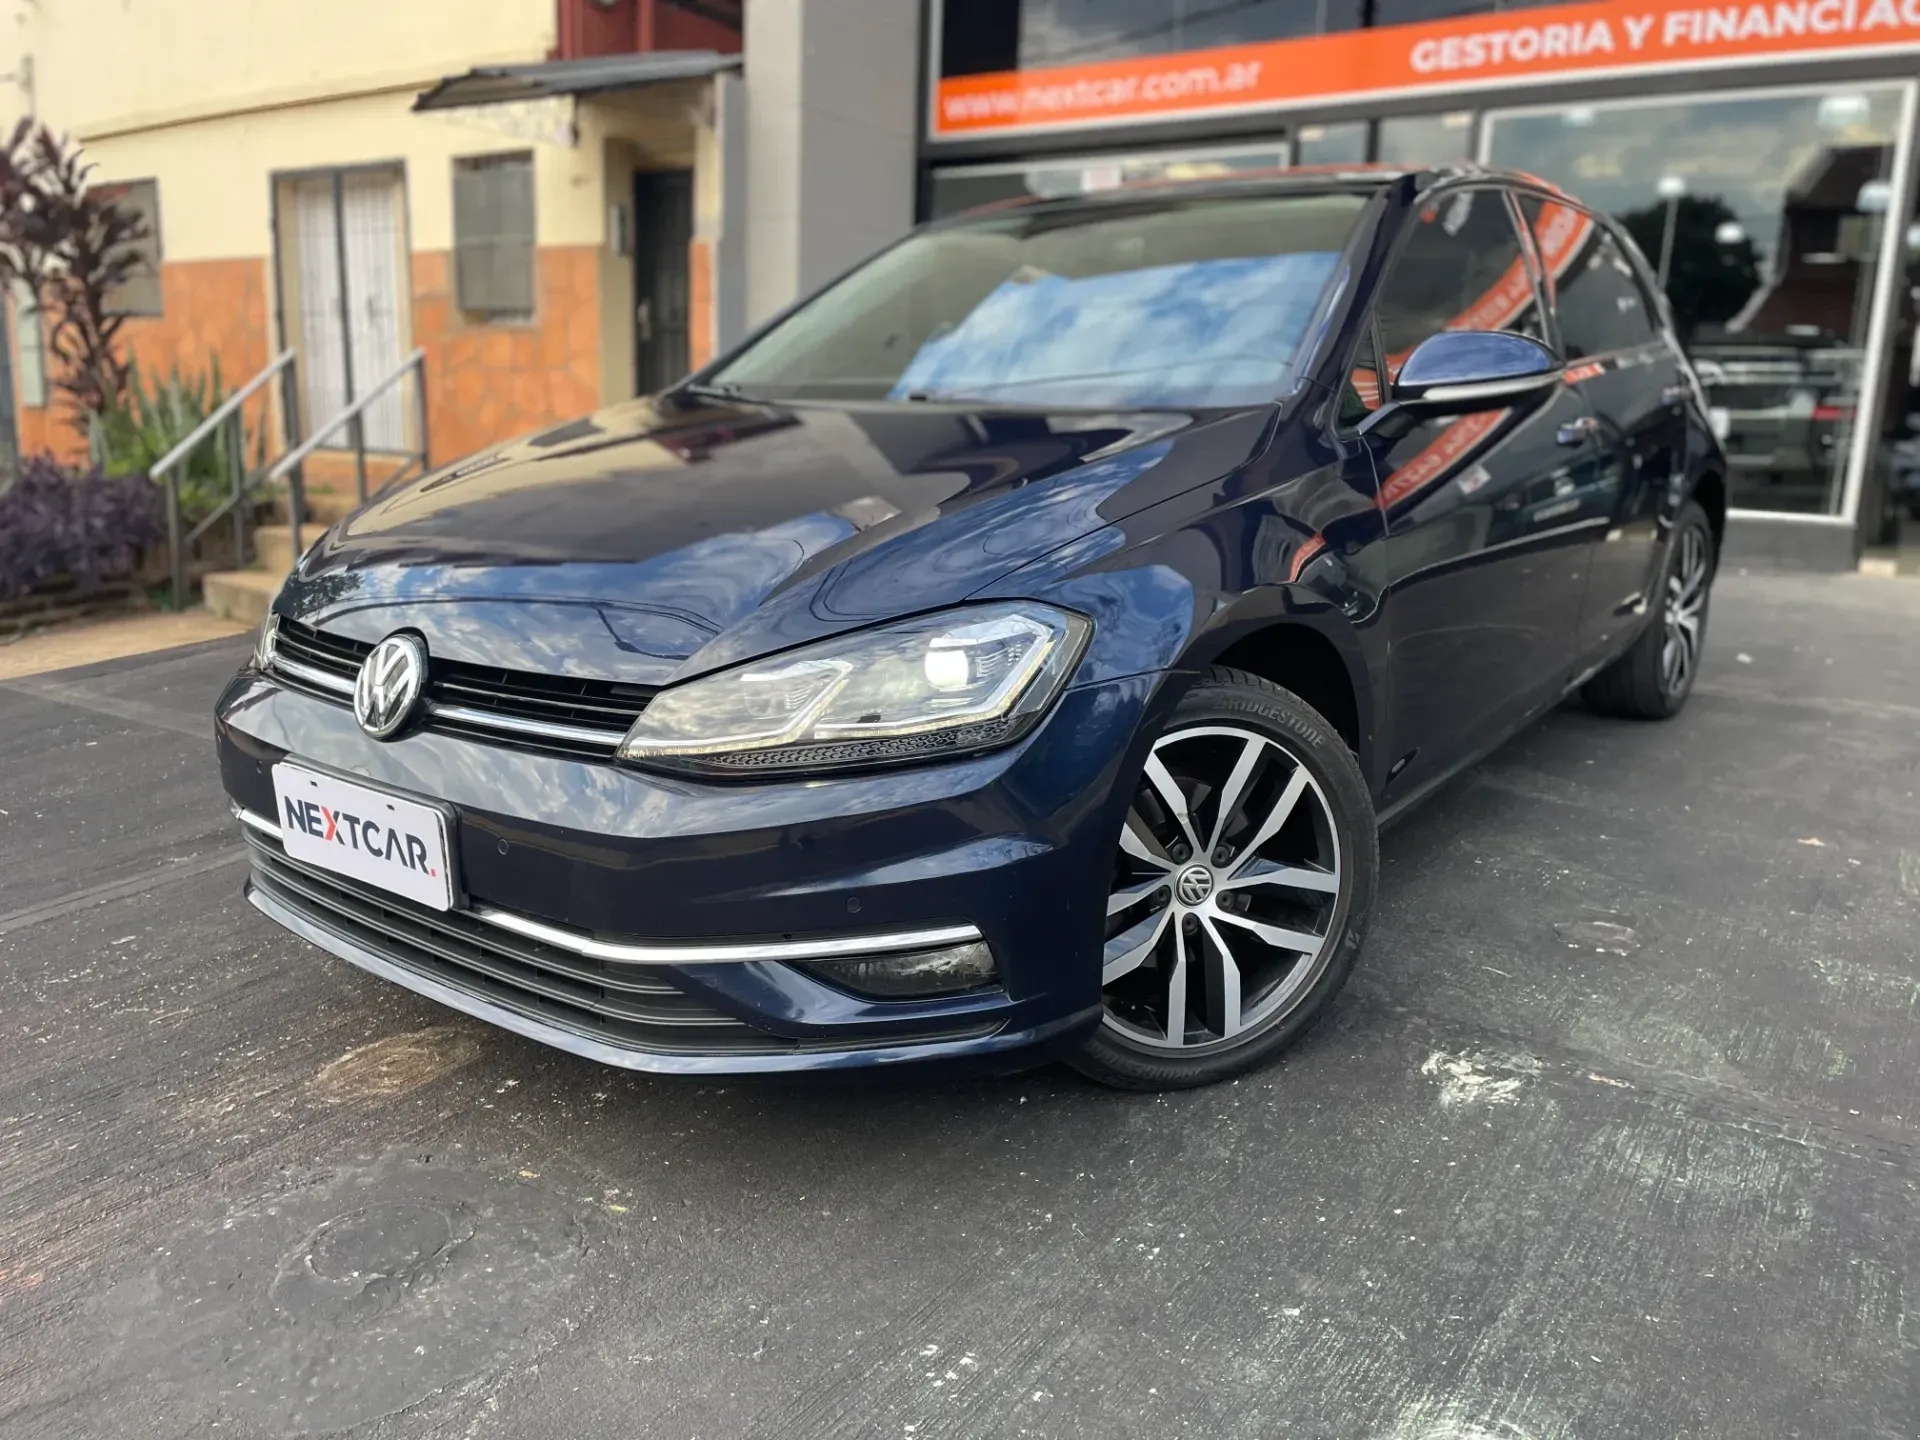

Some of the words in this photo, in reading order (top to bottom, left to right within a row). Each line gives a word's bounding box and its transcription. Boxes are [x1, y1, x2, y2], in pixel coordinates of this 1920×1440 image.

[1410, 20, 1615, 73] GESTORIA
[1623, 15, 1655, 49] Y
[1211, 697, 1326, 749] BRIDGESTONE
